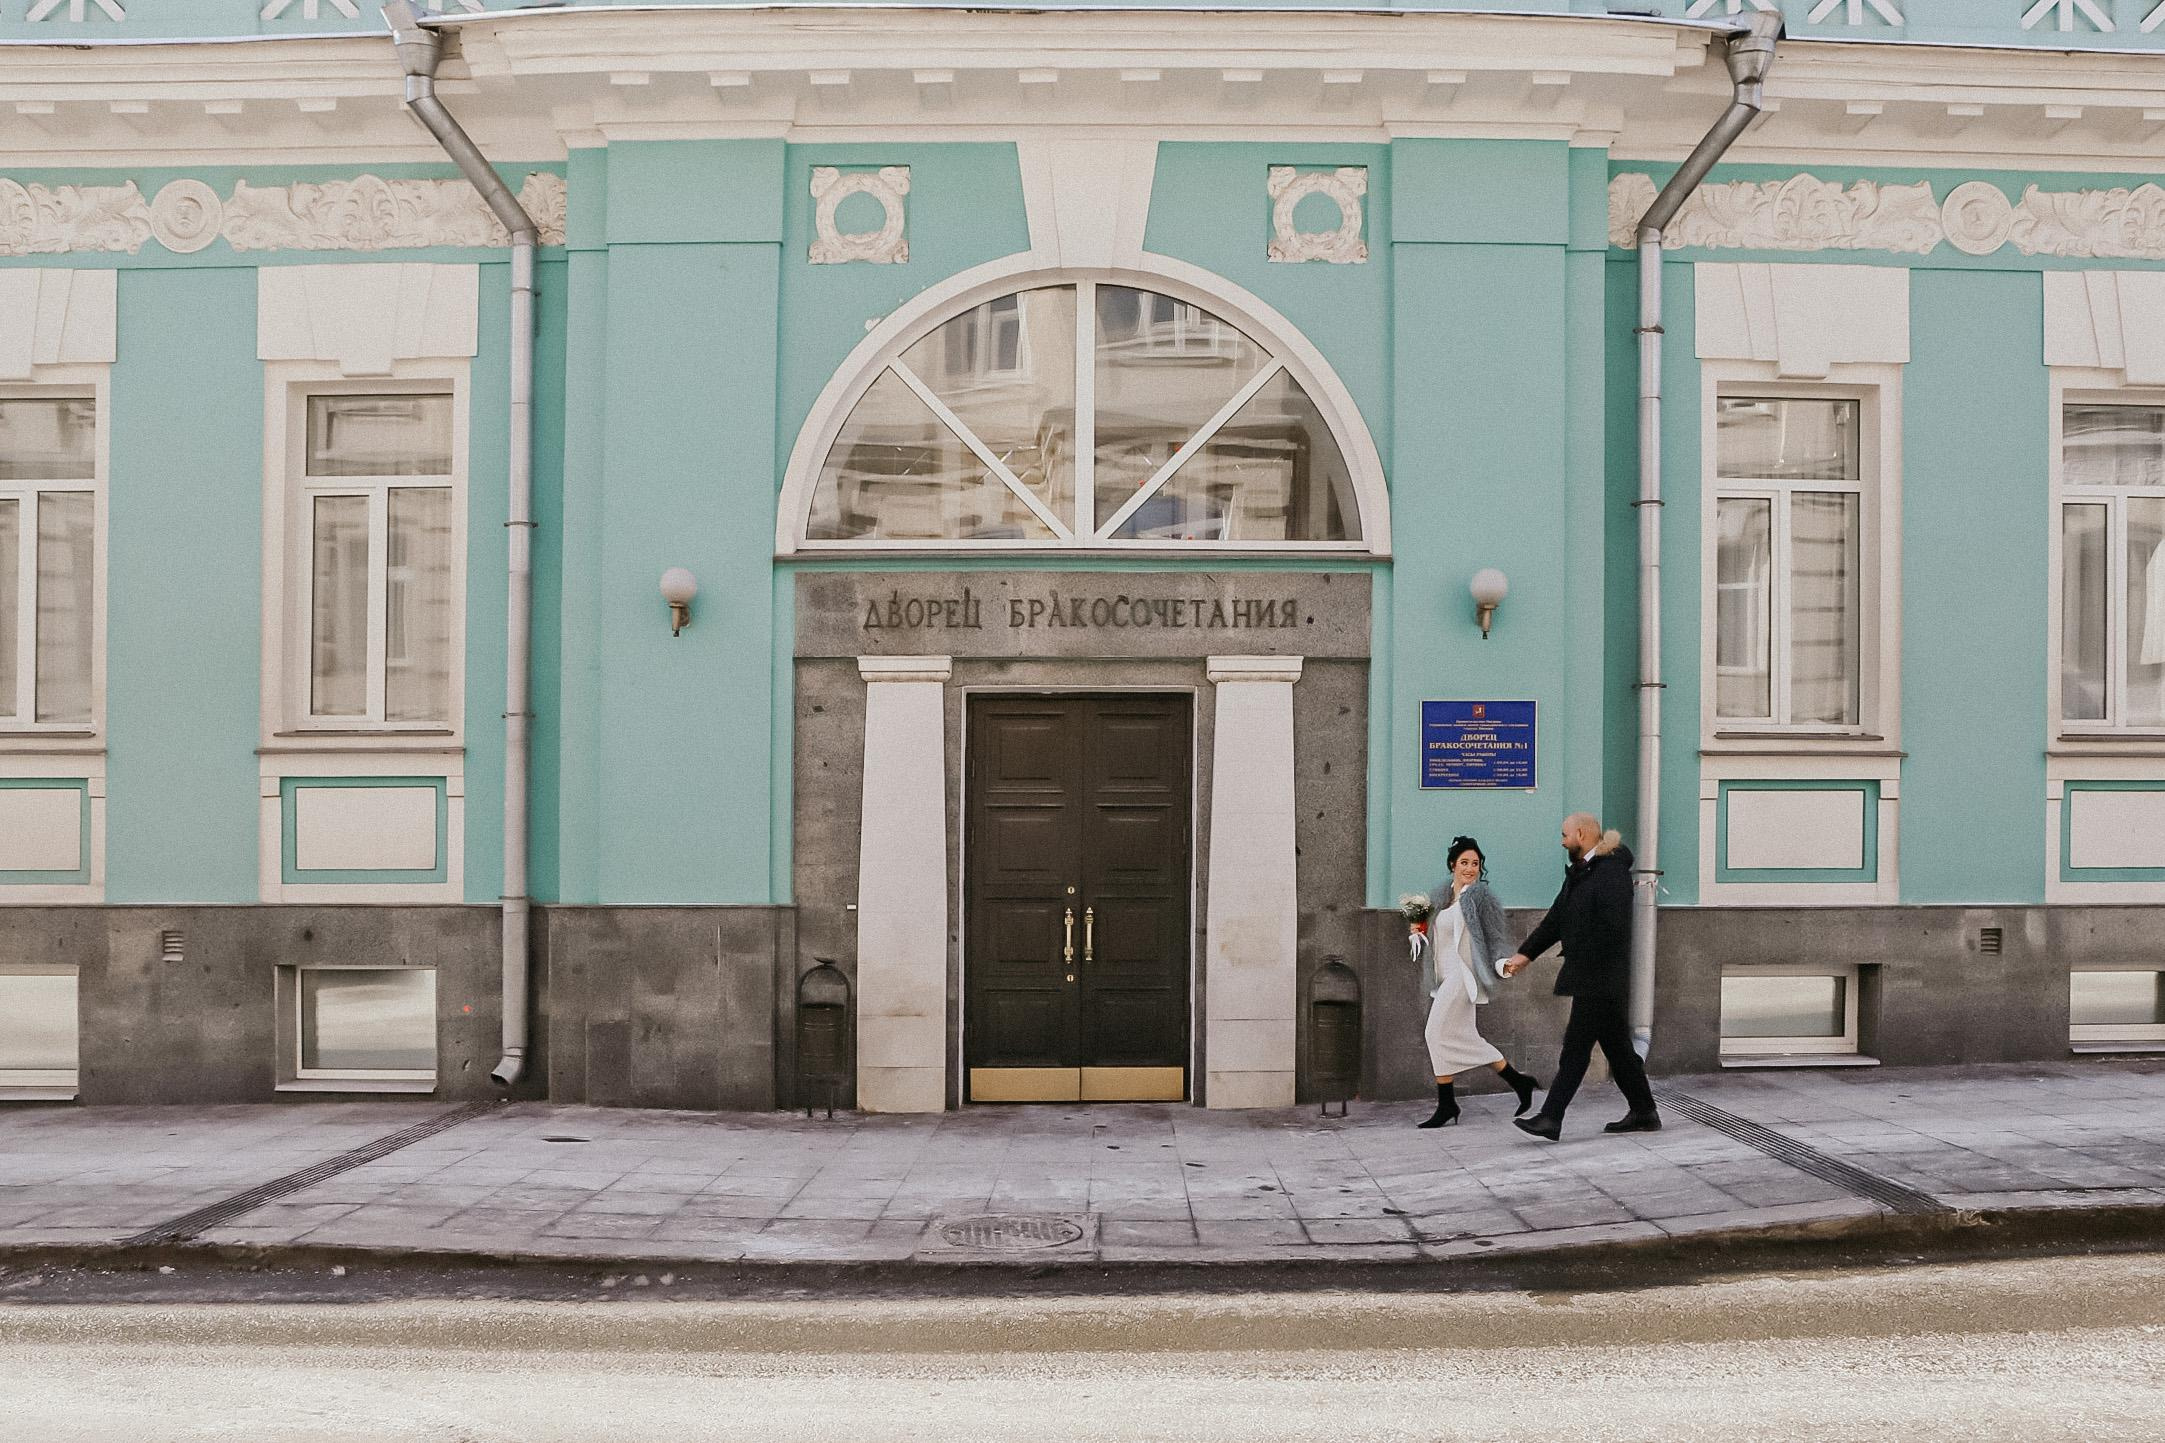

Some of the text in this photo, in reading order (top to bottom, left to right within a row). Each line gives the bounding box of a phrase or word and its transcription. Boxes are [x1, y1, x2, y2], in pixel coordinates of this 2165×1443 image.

[863, 597, 1298, 630] ДВОРЕЦ БРАКОСОЧЕТАНИЯ
[1460, 733, 1498, 742] ДВОРЕЦ
[1429, 742, 1512, 750] БРАКОСОЧЕТАНИЯ
